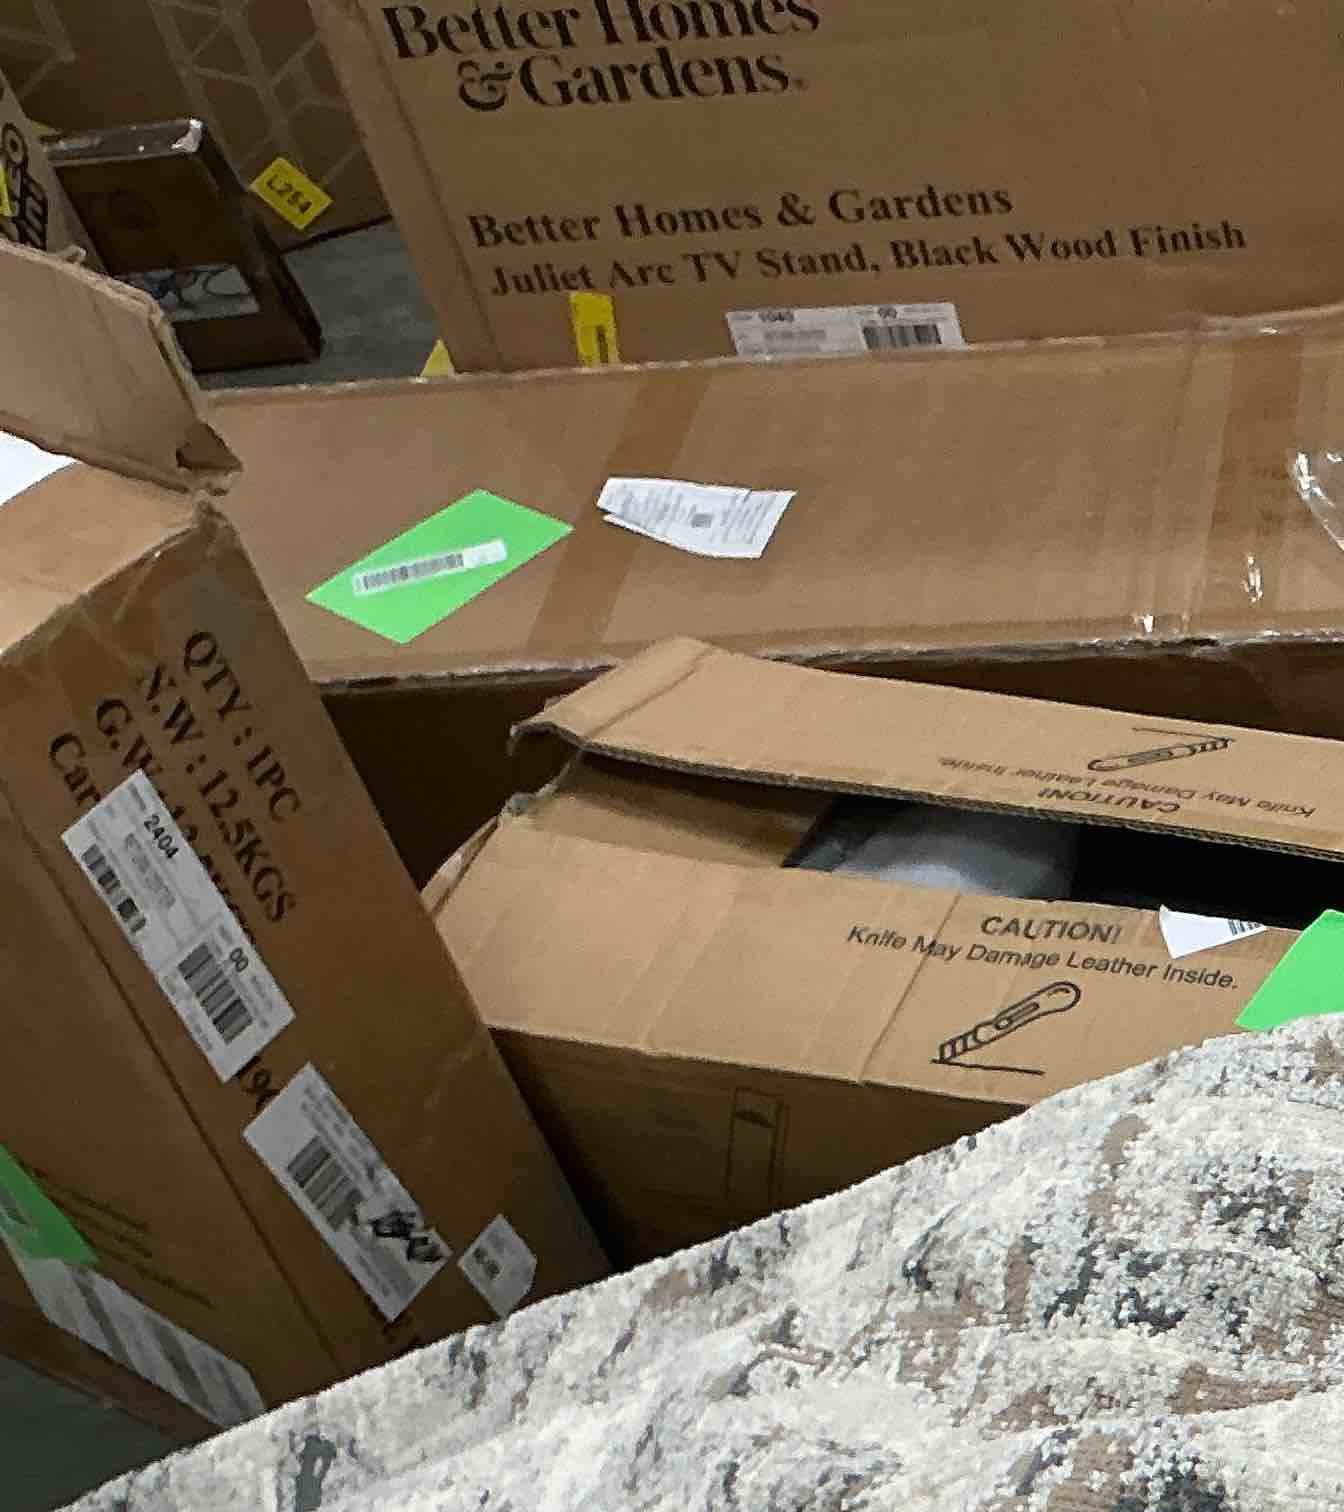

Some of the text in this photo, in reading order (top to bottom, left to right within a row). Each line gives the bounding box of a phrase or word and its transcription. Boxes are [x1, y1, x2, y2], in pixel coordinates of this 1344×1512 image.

[383, 0, 819, 58] Better Homes
[469, 184, 1013, 248] Better Homes & Gardens
[491, 219, 1248, 296] Juliet Arc TV Stand, Black Wood Finish
[183, 631, 252, 723] QTY
[1038, 787, 1182, 815] CAUTION!
[143, 813, 180, 861] 2404
[200, 768, 297, 923] 12.5KGS
[847, 925, 1239, 991] Knife May Damage Leather Inside.
[980, 915, 1121, 946] CAUTION!
